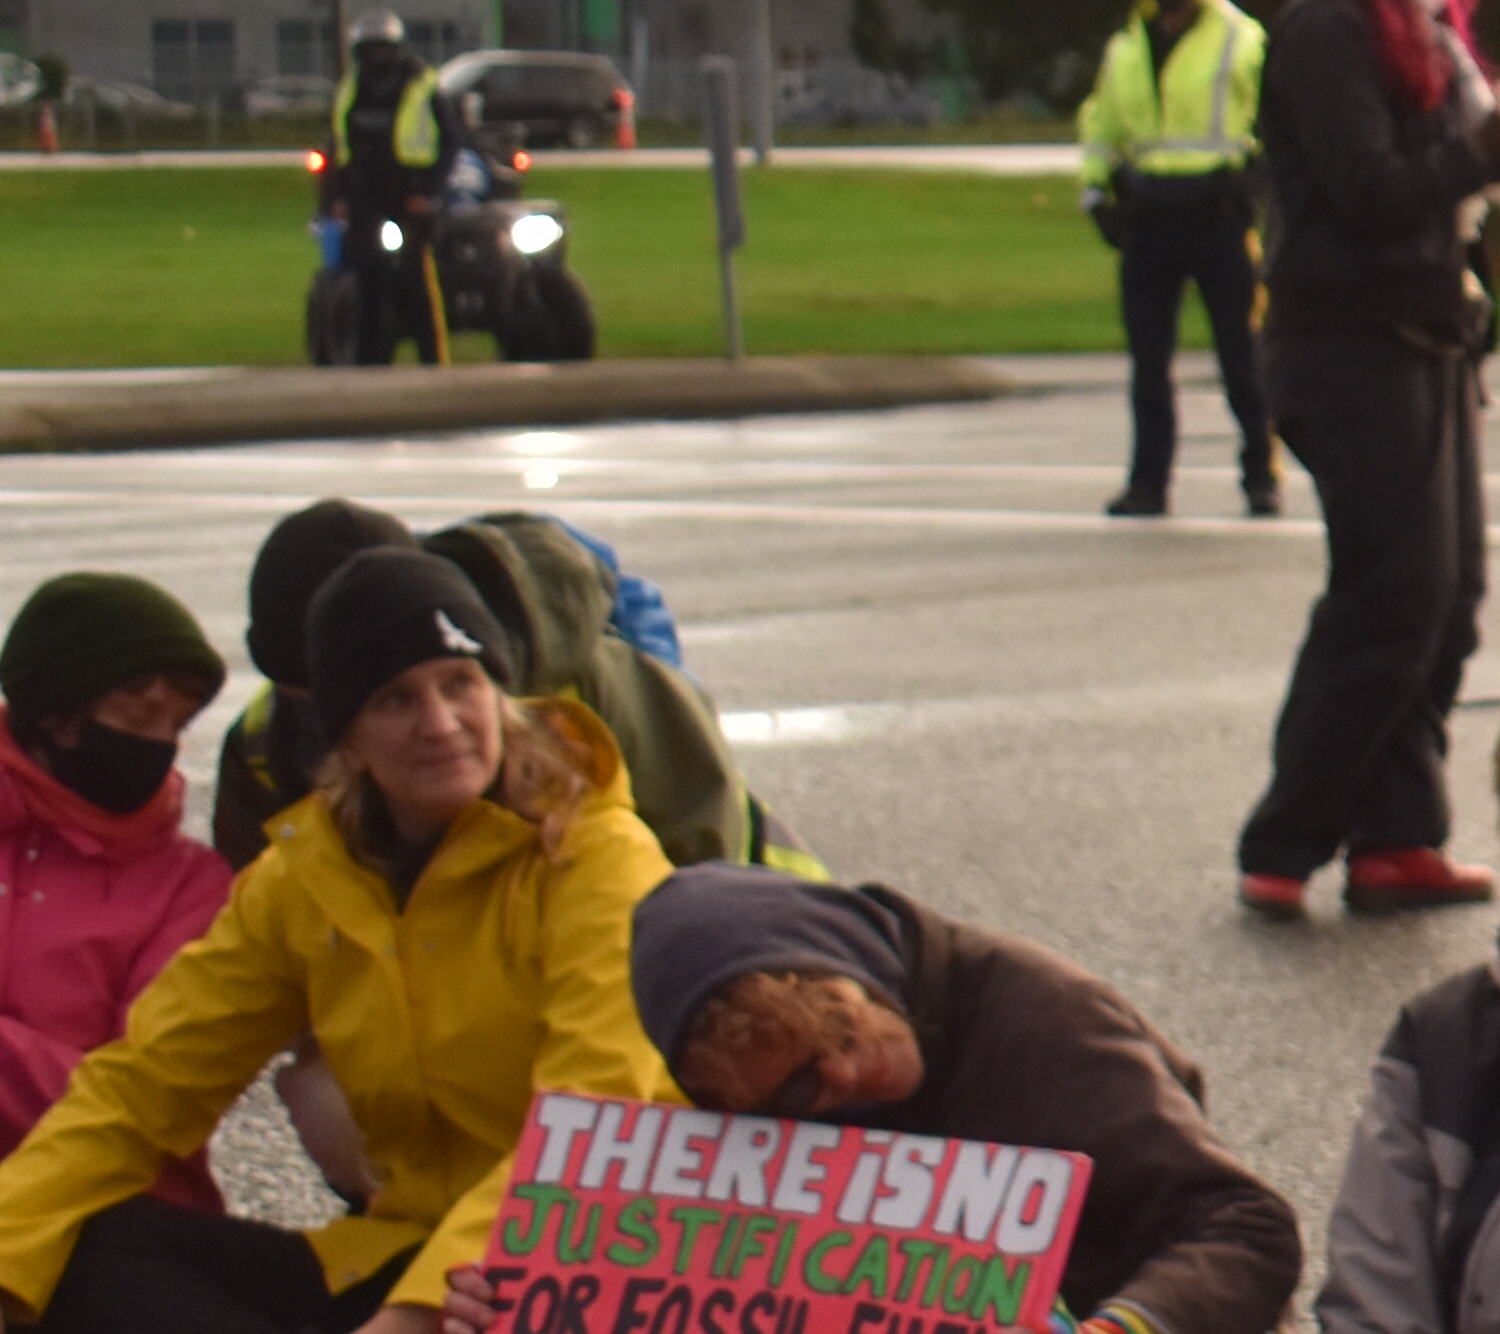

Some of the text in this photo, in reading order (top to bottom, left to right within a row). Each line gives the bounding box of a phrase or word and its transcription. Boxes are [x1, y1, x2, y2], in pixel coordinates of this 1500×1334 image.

[534, 1091, 843, 1216] THERE
[932, 1138, 1074, 1255] NO
[502, 1182, 1031, 1327] JUSTIFICATION
